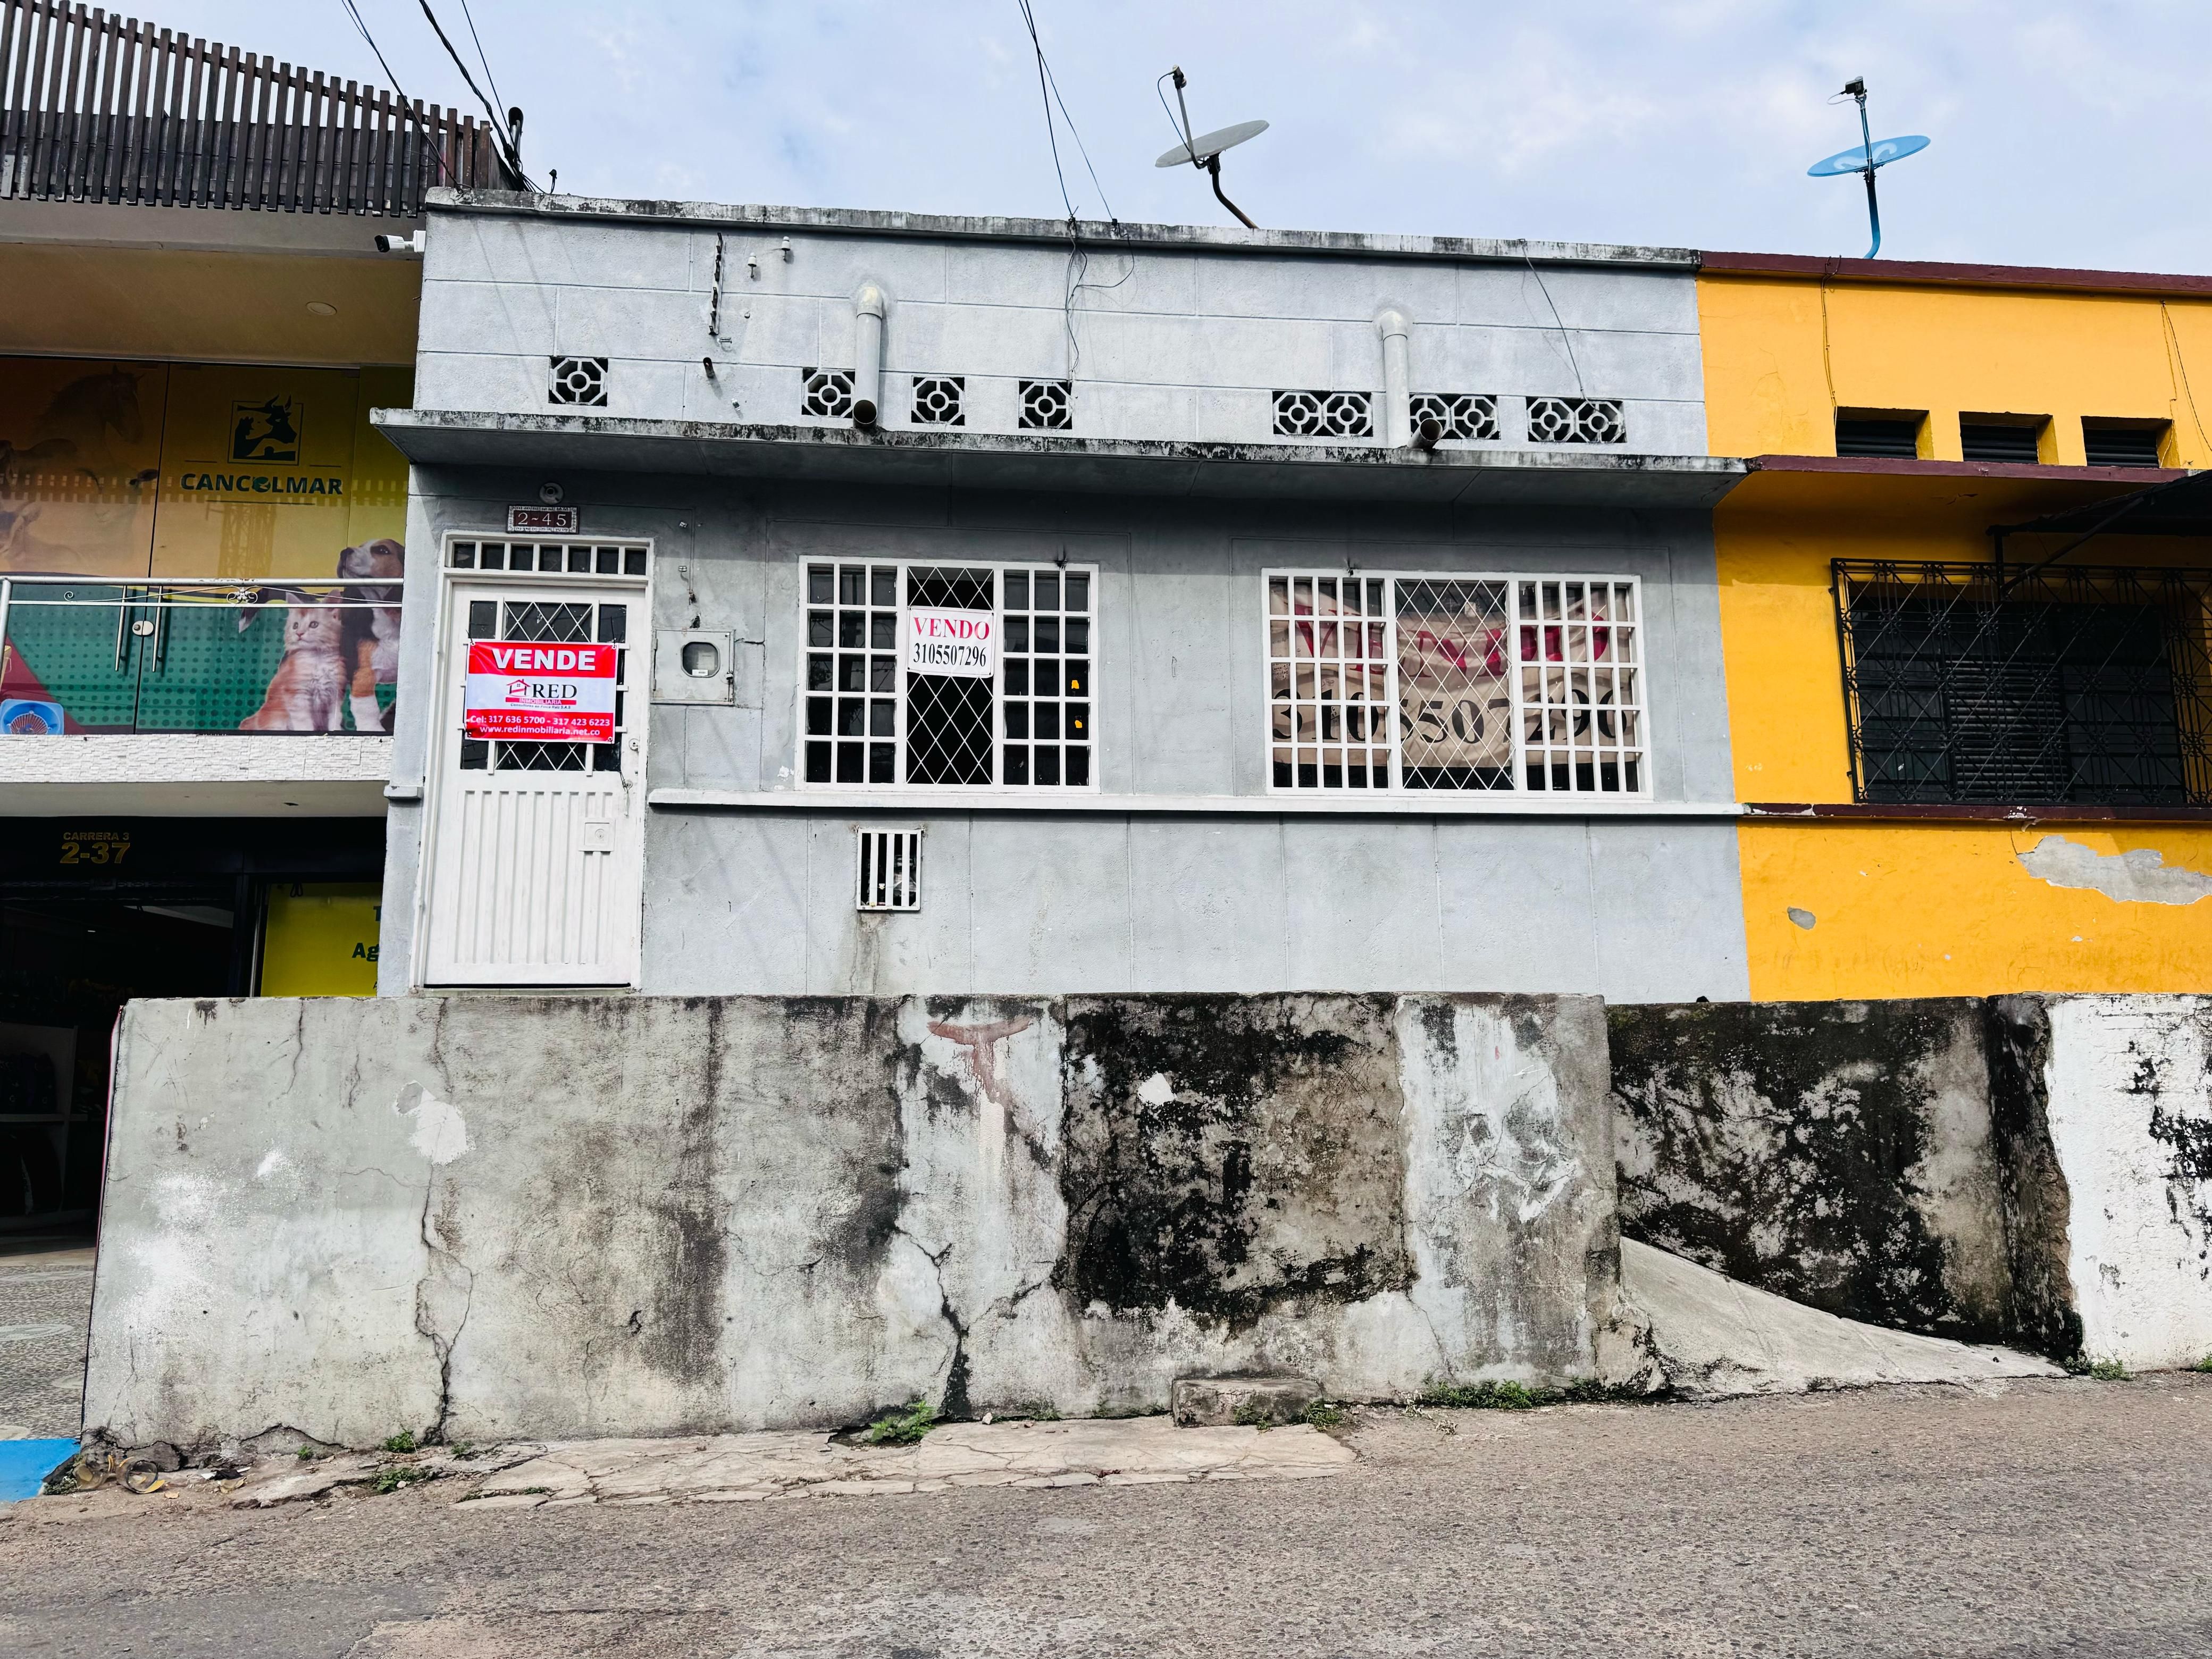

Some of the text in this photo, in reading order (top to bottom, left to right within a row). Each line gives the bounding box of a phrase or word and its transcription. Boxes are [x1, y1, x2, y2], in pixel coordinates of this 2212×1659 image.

[181, 473, 342, 495] CANCOLMAR
[914, 617, 990, 640] VENDO
[492, 648, 596, 671] VENDE
[913, 642, 986, 667] 3105507296
[532, 683, 577, 698] RED
[480, 725, 600, 736] www.redinmobiliaria.net.co
[60, 842, 130, 864] 2-37
